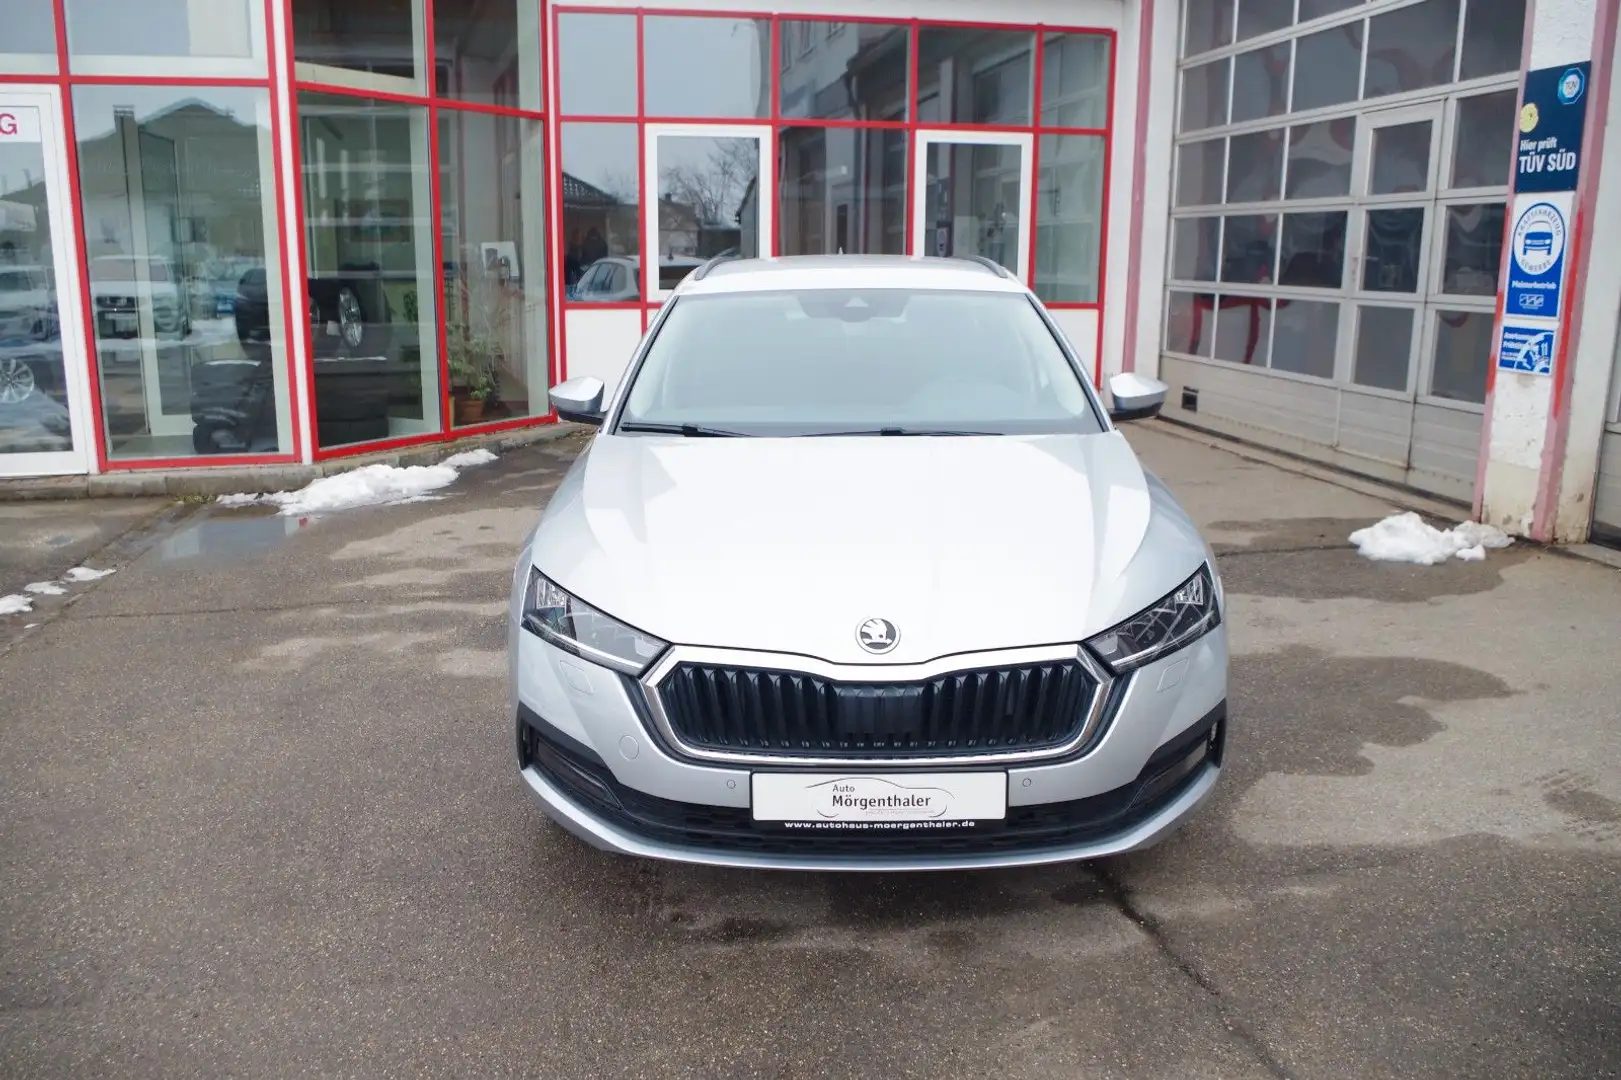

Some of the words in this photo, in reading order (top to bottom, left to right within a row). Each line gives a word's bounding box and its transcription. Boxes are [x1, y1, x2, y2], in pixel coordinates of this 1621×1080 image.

[1520, 140, 1536, 152] Hier
[1537, 137, 1557, 152] prüft
[1519, 152, 1546, 174] TÜV
[1547, 149, 1576, 171] SÜD
[832, 784, 855, 793] Auto
[832, 794, 931, 810] Mörgenthaler
[784, 820, 975, 830] www.autohaus-moergenthaler.de
